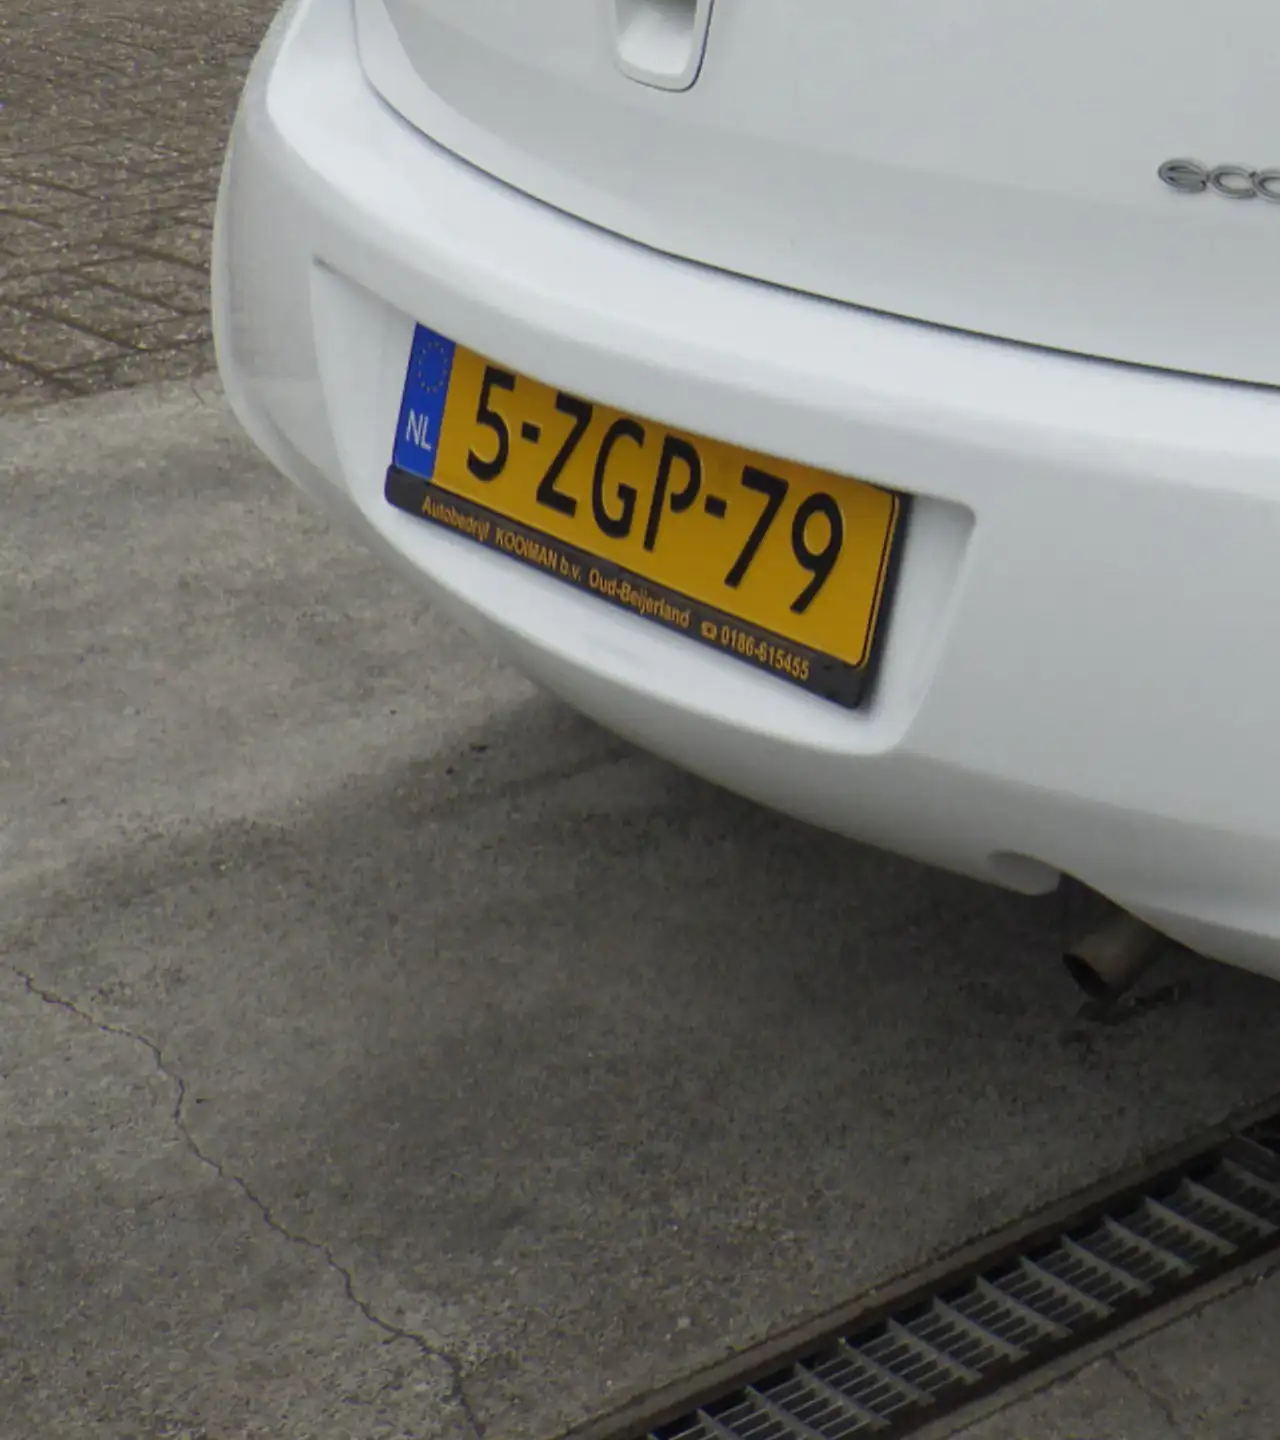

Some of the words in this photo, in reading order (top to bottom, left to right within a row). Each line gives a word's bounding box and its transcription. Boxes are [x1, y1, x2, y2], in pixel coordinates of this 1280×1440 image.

[405, 407, 432, 452] NL
[467, 365, 845, 615] 5-ZGP-79
[421, 494, 491, 543] Autobedrijf
[588, 567, 692, 629] Oud-Beijerland
[720, 625, 810, 681] 0186-615455
